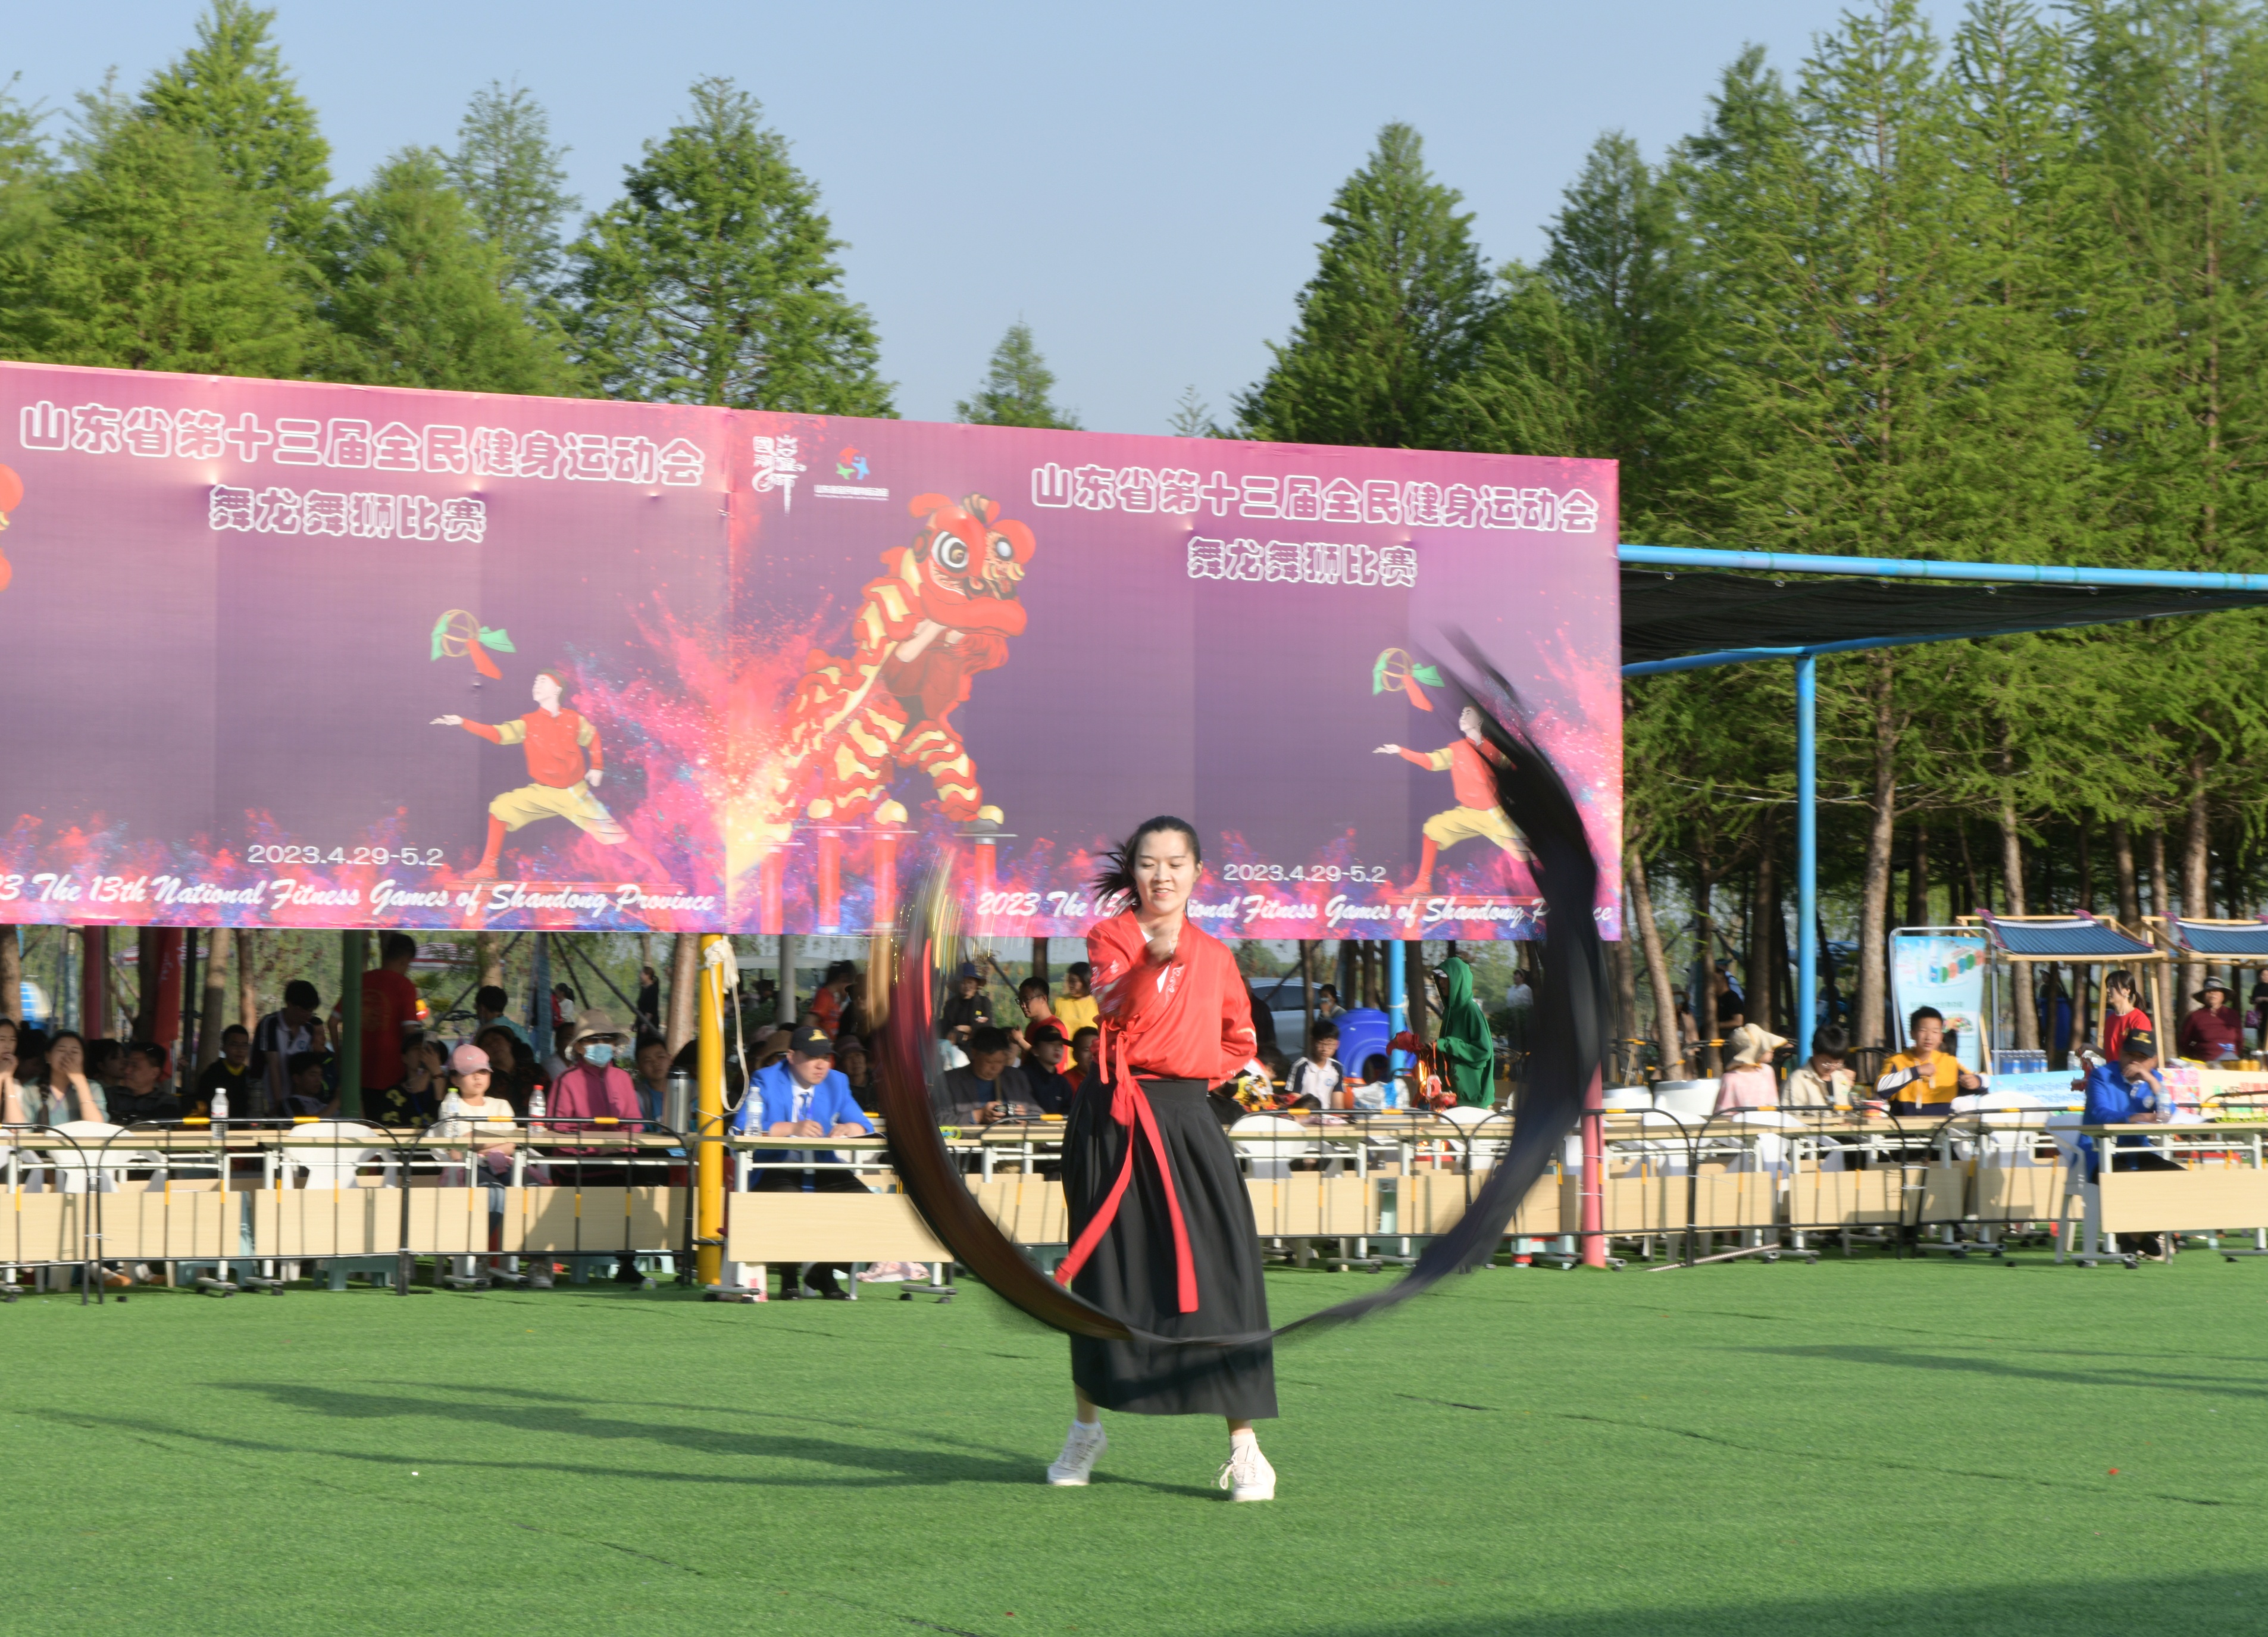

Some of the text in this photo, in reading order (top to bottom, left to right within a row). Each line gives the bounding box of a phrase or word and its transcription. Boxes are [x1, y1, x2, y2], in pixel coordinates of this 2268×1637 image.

[20, 401, 705, 486] 山东省第十三届全民健身运动会
[208, 484, 487, 543] 舞龙舞狮比赛
[1031, 463, 1598, 533] 山东省第十三届全民健身运动会
[1187, 536, 1418, 588] 舞龙舞狮比赛
[248, 845, 444, 866] 2023.4.29-5.2
[1224, 864, 1387, 883] 2023.4.29-5.2
[32, 873, 82, 902] The
[89, 876, 148, 902] 13th
[151, 875, 266, 905] National
[270, 879, 361, 910] Fitness
[369, 879, 449, 915] Games
[456, 884, 481, 916] of
[487, 883, 608, 918] Shandong
[615, 884, 715, 912] Province
[977, 892, 1040, 916] 2023
[1046, 891, 1087, 917] The
[1187, 895, 1240, 919] ional
[1243, 895, 1317, 923] Fitness
[1325, 894, 1393, 927] Games
[1397, 898, 1419, 928] of
[1422, 896, 1525, 929] Shandong
